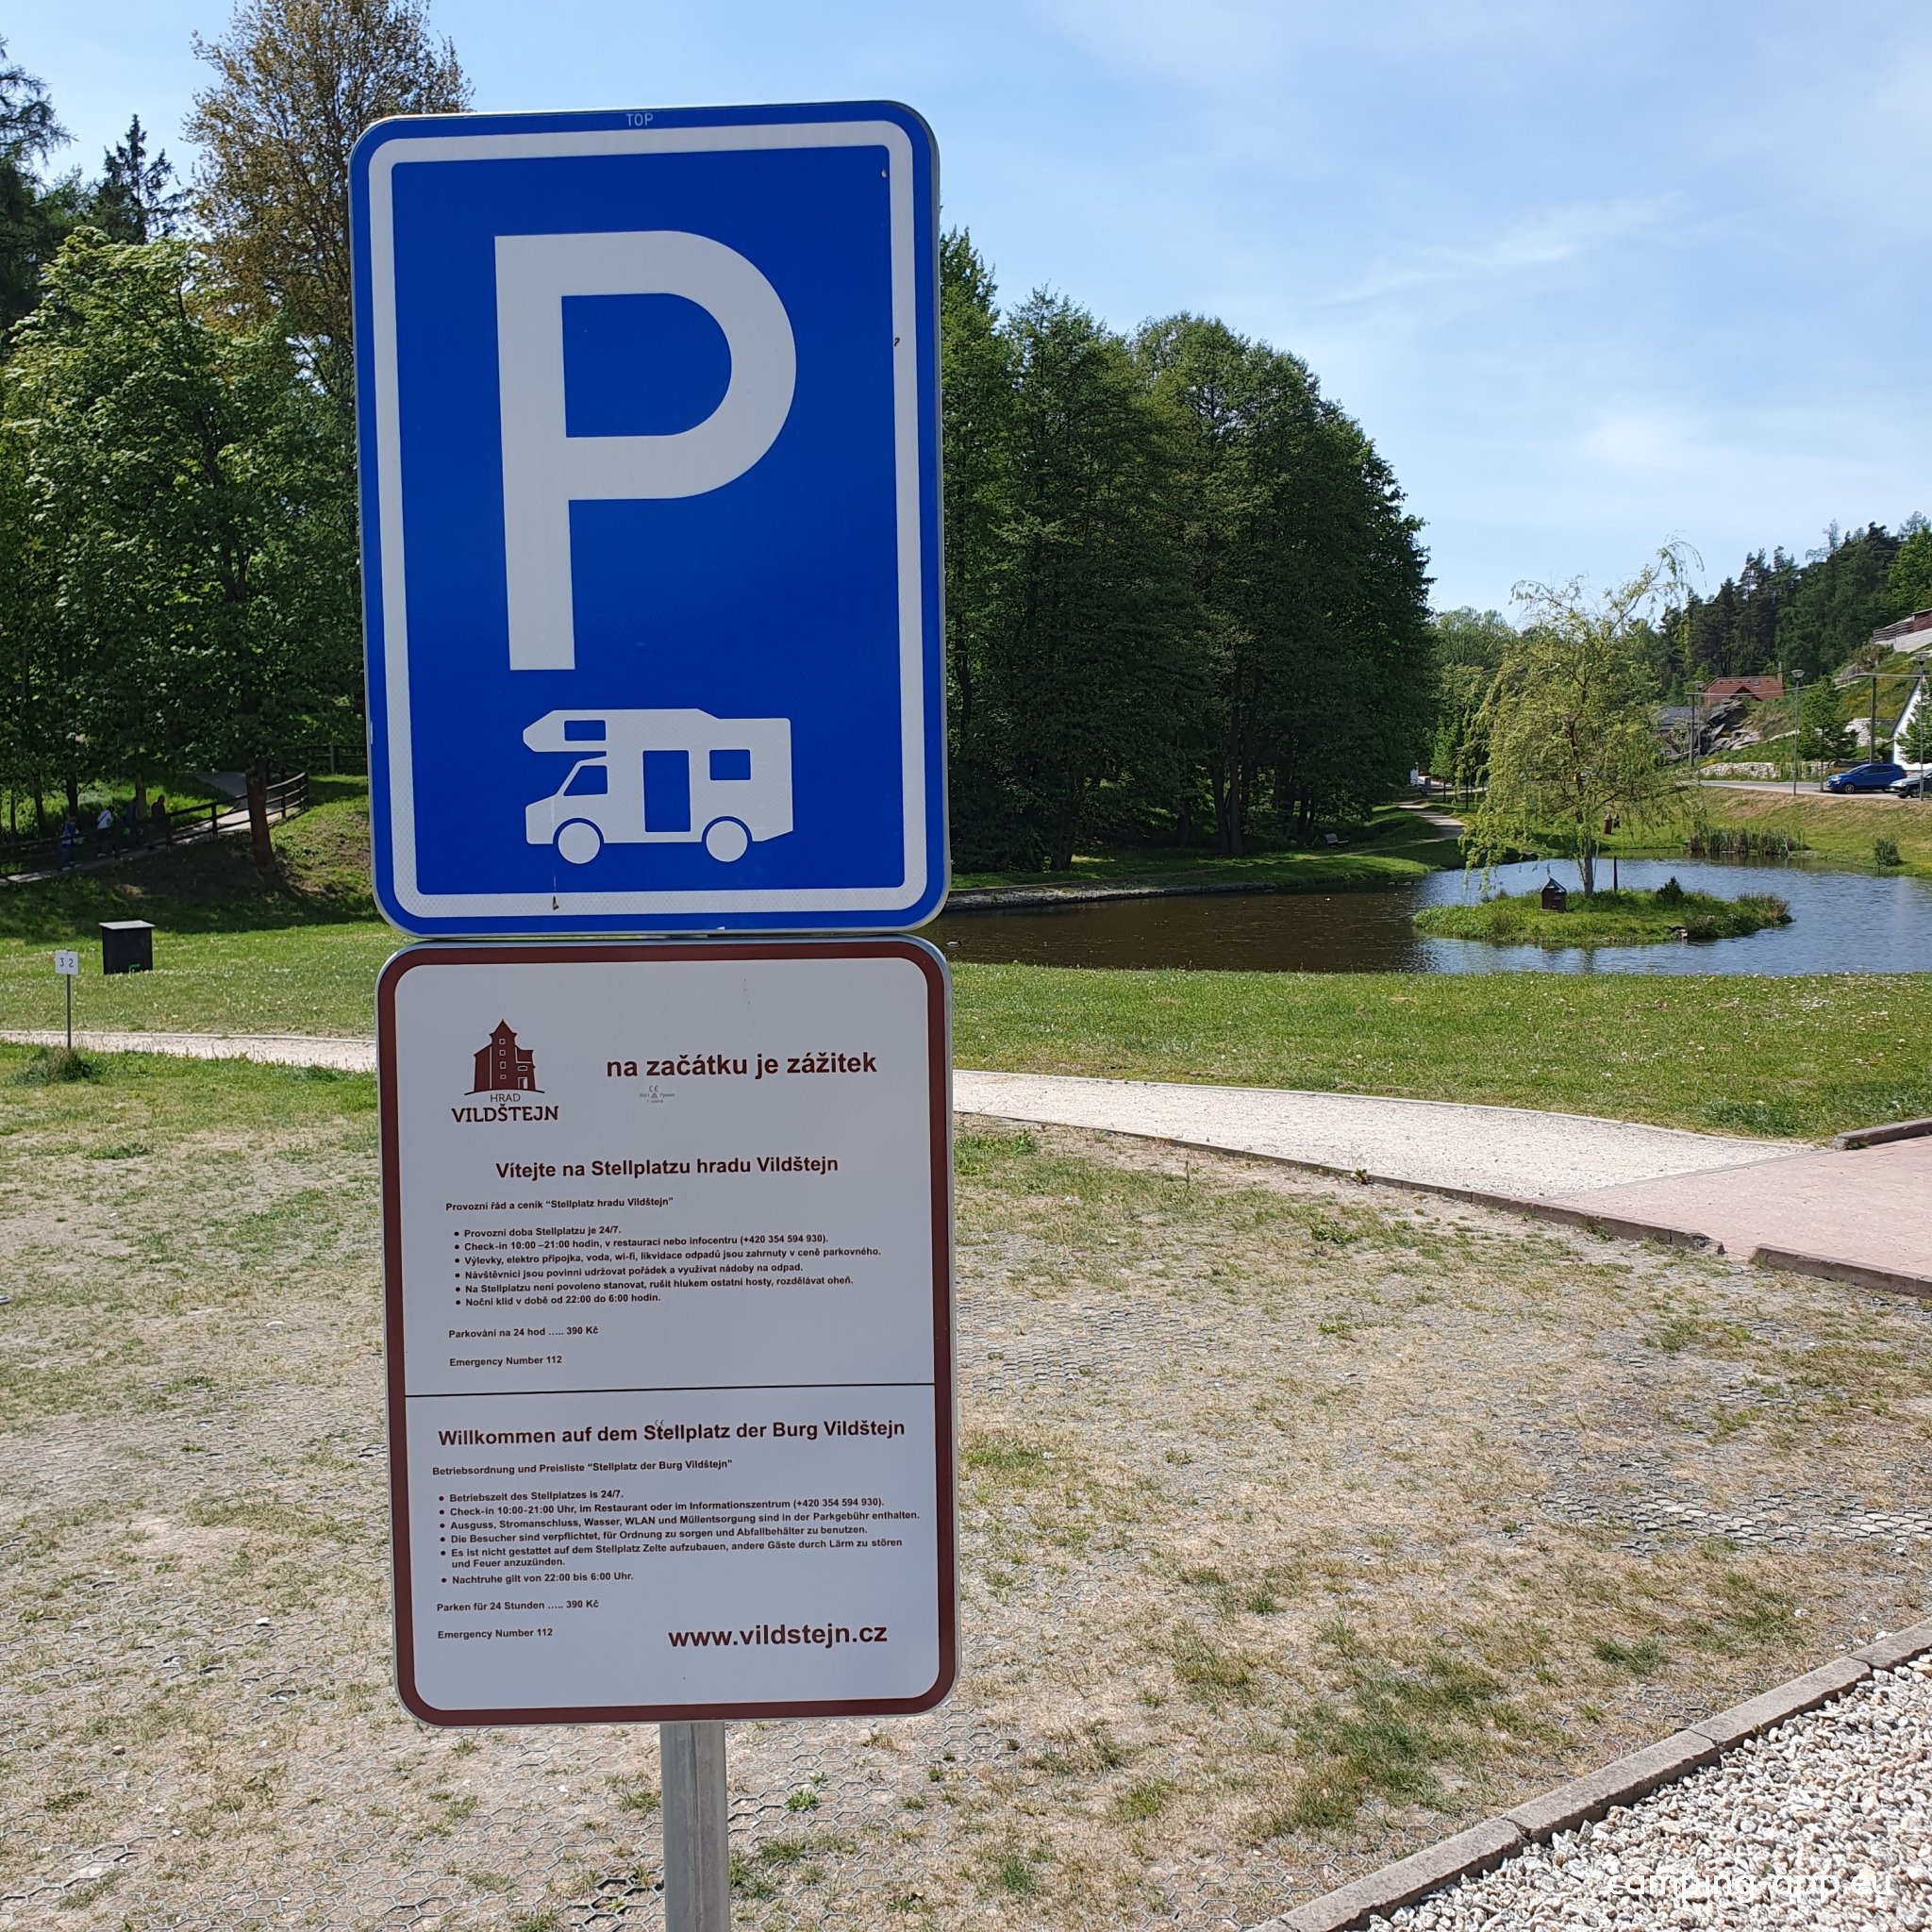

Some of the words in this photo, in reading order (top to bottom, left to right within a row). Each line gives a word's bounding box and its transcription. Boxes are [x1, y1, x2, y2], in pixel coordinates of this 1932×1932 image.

[626, 112, 654, 127] TOP
[494, 230, 797, 671] P
[607, 1060, 639, 1077] na
[646, 1054, 747, 1076] začátku
[754, 1053, 779, 1079] je
[787, 1051, 877, 1074] zážitek
[490, 1093, 521, 1103] HRAD
[451, 1103, 559, 1124] VILDŠTEJN
[495, 1161, 557, 1182] Vítejte
[562, 1164, 586, 1177] na
[591, 1158, 691, 1179] Stellplatzu
[696, 1157, 751, 1174] hradu
[756, 1156, 839, 1175] Vildštejn
[597, 1198, 625, 1208] hradu
[508, 1227, 533, 1237] doba
[535, 1226, 586, 1238] Stellplatzu
[587, 1225, 597, 1237] je
[598, 1224, 622, 1235] 24/7.
[464, 1241, 508, 1252] Check-in
[572, 1239, 603, 1249] hodin,
[612, 1237, 661, 1247] restauraci
[663, 1237, 688, 1246] nebo
[689, 1236, 738, 1245] infocentru
[740, 1235, 766, 1246] (+420
[768, 1234, 785, 1243] 354
[787, 1234, 804, 1243] 594
[806, 1233, 829, 1244] 930).
[506, 1255, 540, 1264] elektro
[586, 1252, 612, 1262] voda,
[641, 1251, 683, 1260] likvidace
[722, 1249, 744, 1260] jsou
[745, 1248, 788, 1259] zahrnuty
[522, 1269, 544, 1280] jsou
[546, 1267, 582, 1279] povinni
[771, 1262, 804, 1274] odpad.
[465, 1284, 478, 1293] Na
[480, 1283, 531, 1294] Stellplatzu
[556, 1281, 602, 1293] povoleno
[603, 1280, 647, 1290] stanovat,
[673, 1278, 708, 1288] hlukem
[745, 1277, 774, 1288] hosty,
[495, 1296, 514, 1306] klid
[550, 1295, 563, 1305] od
[565, 1294, 591, 1304] 22:00
[593, 1294, 607, 1303] do
[608, 1293, 629, 1303] 6:00
[631, 1292, 661, 1303] hodin.
[513, 1327, 525, 1337] 24
[526, 1327, 546, 1337] hod
[566, 1326, 584, 1336] 390
[585, 1325, 599, 1335] Kč
[449, 1357, 504, 1368] Emergency
[506, 1356, 544, 1365] Number
[545, 1355, 562, 1364] 112
[438, 1429, 556, 1446] Willkommen
[561, 1426, 592, 1442] auf
[597, 1425, 638, 1441] dem
[643, 1424, 731, 1443] Stellplatz
[736, 1423, 767, 1439] der
[773, 1422, 818, 1441] Burg
[823, 1420, 905, 1440] Vildštejn
[432, 1465, 515, 1475] Betriebsordnung
[517, 1464, 537, 1474] und
[539, 1463, 585, 1473] Preisliste
[640, 1461, 657, 1471] der
[658, 1460, 683, 1472] Burg
[449, 1492, 508, 1503] Betriebszeit
[509, 1491, 528, 1501] des
[530, 1491, 588, 1502] Stellplatzes
[590, 1490, 599, 1499] is
[600, 1489, 625, 1499] 24/7.
[449, 1507, 495, 1517] Check-in
[497, 1505, 555, 1515] 10:00-21:00
[557, 1505, 577, 1514] Uhr,
[579, 1504, 592, 1513] im
[593, 1503, 648, 1513] Restaurant
[649, 1502, 673, 1511] oder
[675, 1502, 688, 1511] im
[689, 1500, 791, 1510] Informationszentrum
[792, 1498, 820, 1510] (+420
[822, 1498, 840, 1507] 354
[841, 1497, 859, 1507] 594
[860, 1497, 885, 1508] 930).
[449, 1521, 497, 1531] Ausguss,
[498, 1518, 582, 1529] Stromanschluss,
[583, 1517, 623, 1527] Wasser,
[624, 1516, 656, 1525] WLAN
[658, 1515, 677, 1525] und
[679, 1514, 757, 1525] Müllentsorgung
[758, 1513, 780, 1523] sind
[782, 1513, 791, 1522] in
[793, 1512, 810, 1522] der
[812, 1511, 870, 1523] Parkgebühr
[872, 1510, 921, 1520] enthalten.
[450, 1534, 467, 1543] Die
[469, 1533, 517, 1543] Besucher
[518, 1532, 541, 1542] sind
[541, 1531, 601, 1543] verpflichtet,
[602, 1530, 618, 1540] für
[619, 1530, 663, 1541] Ordnung
[678, 1530, 713, 1540] sorgen
[715, 1527, 735, 1538] und
[736, 1526, 806, 1537] Abfallbehälter
[820, 1525, 868, 1535] benutzen.
[451, 1548, 464, 1557] Es
[466, 1547, 479, 1557] ist
[481, 1547, 507, 1557] nicht
[508, 1546, 552, 1557] gestattet
[553, 1545, 571, 1555] auf
[572, 1545, 593, 1555] dem
[595, 1544, 641, 1555] Stellplatz
[642, 1543, 667, 1553] Zelte
[669, 1542, 729, 1552] aufzubauen,
[731, 1541, 765, 1551] andere
[767, 1541, 796, 1550] Gäste
[798, 1540, 827, 1549] durch
[829, 1539, 855, 1548] Lärm
[856, 1540, 868, 1548] zu
[871, 1538, 903, 1547] stören
[451, 1558, 471, 1569] und
[473, 1558, 502, 1568] Feuer
[452, 1574, 503, 1585] Nachtruhe
[505, 1574, 522, 1585] gilt
[543, 1573, 571, 1582] 22:00
[573, 1573, 589, 1582] bis
[590, 1572, 611, 1581] 6:00
[613, 1572, 634, 1581] Uhr.
[436, 1603, 472, 1612] Parken
[473, 1602, 489, 1611] für
[490, 1601, 502, 1610] 24
[504, 1601, 545, 1610] Stunden
[565, 1599, 584, 1608] 390
[586, 1599, 600, 1608] Kč
[437, 1630, 493, 1641] Emergency
[495, 1628, 535, 1638] Number
[536, 1627, 554, 1637] 112
[667, 1623, 888, 1649] www.vildstejn.cz
